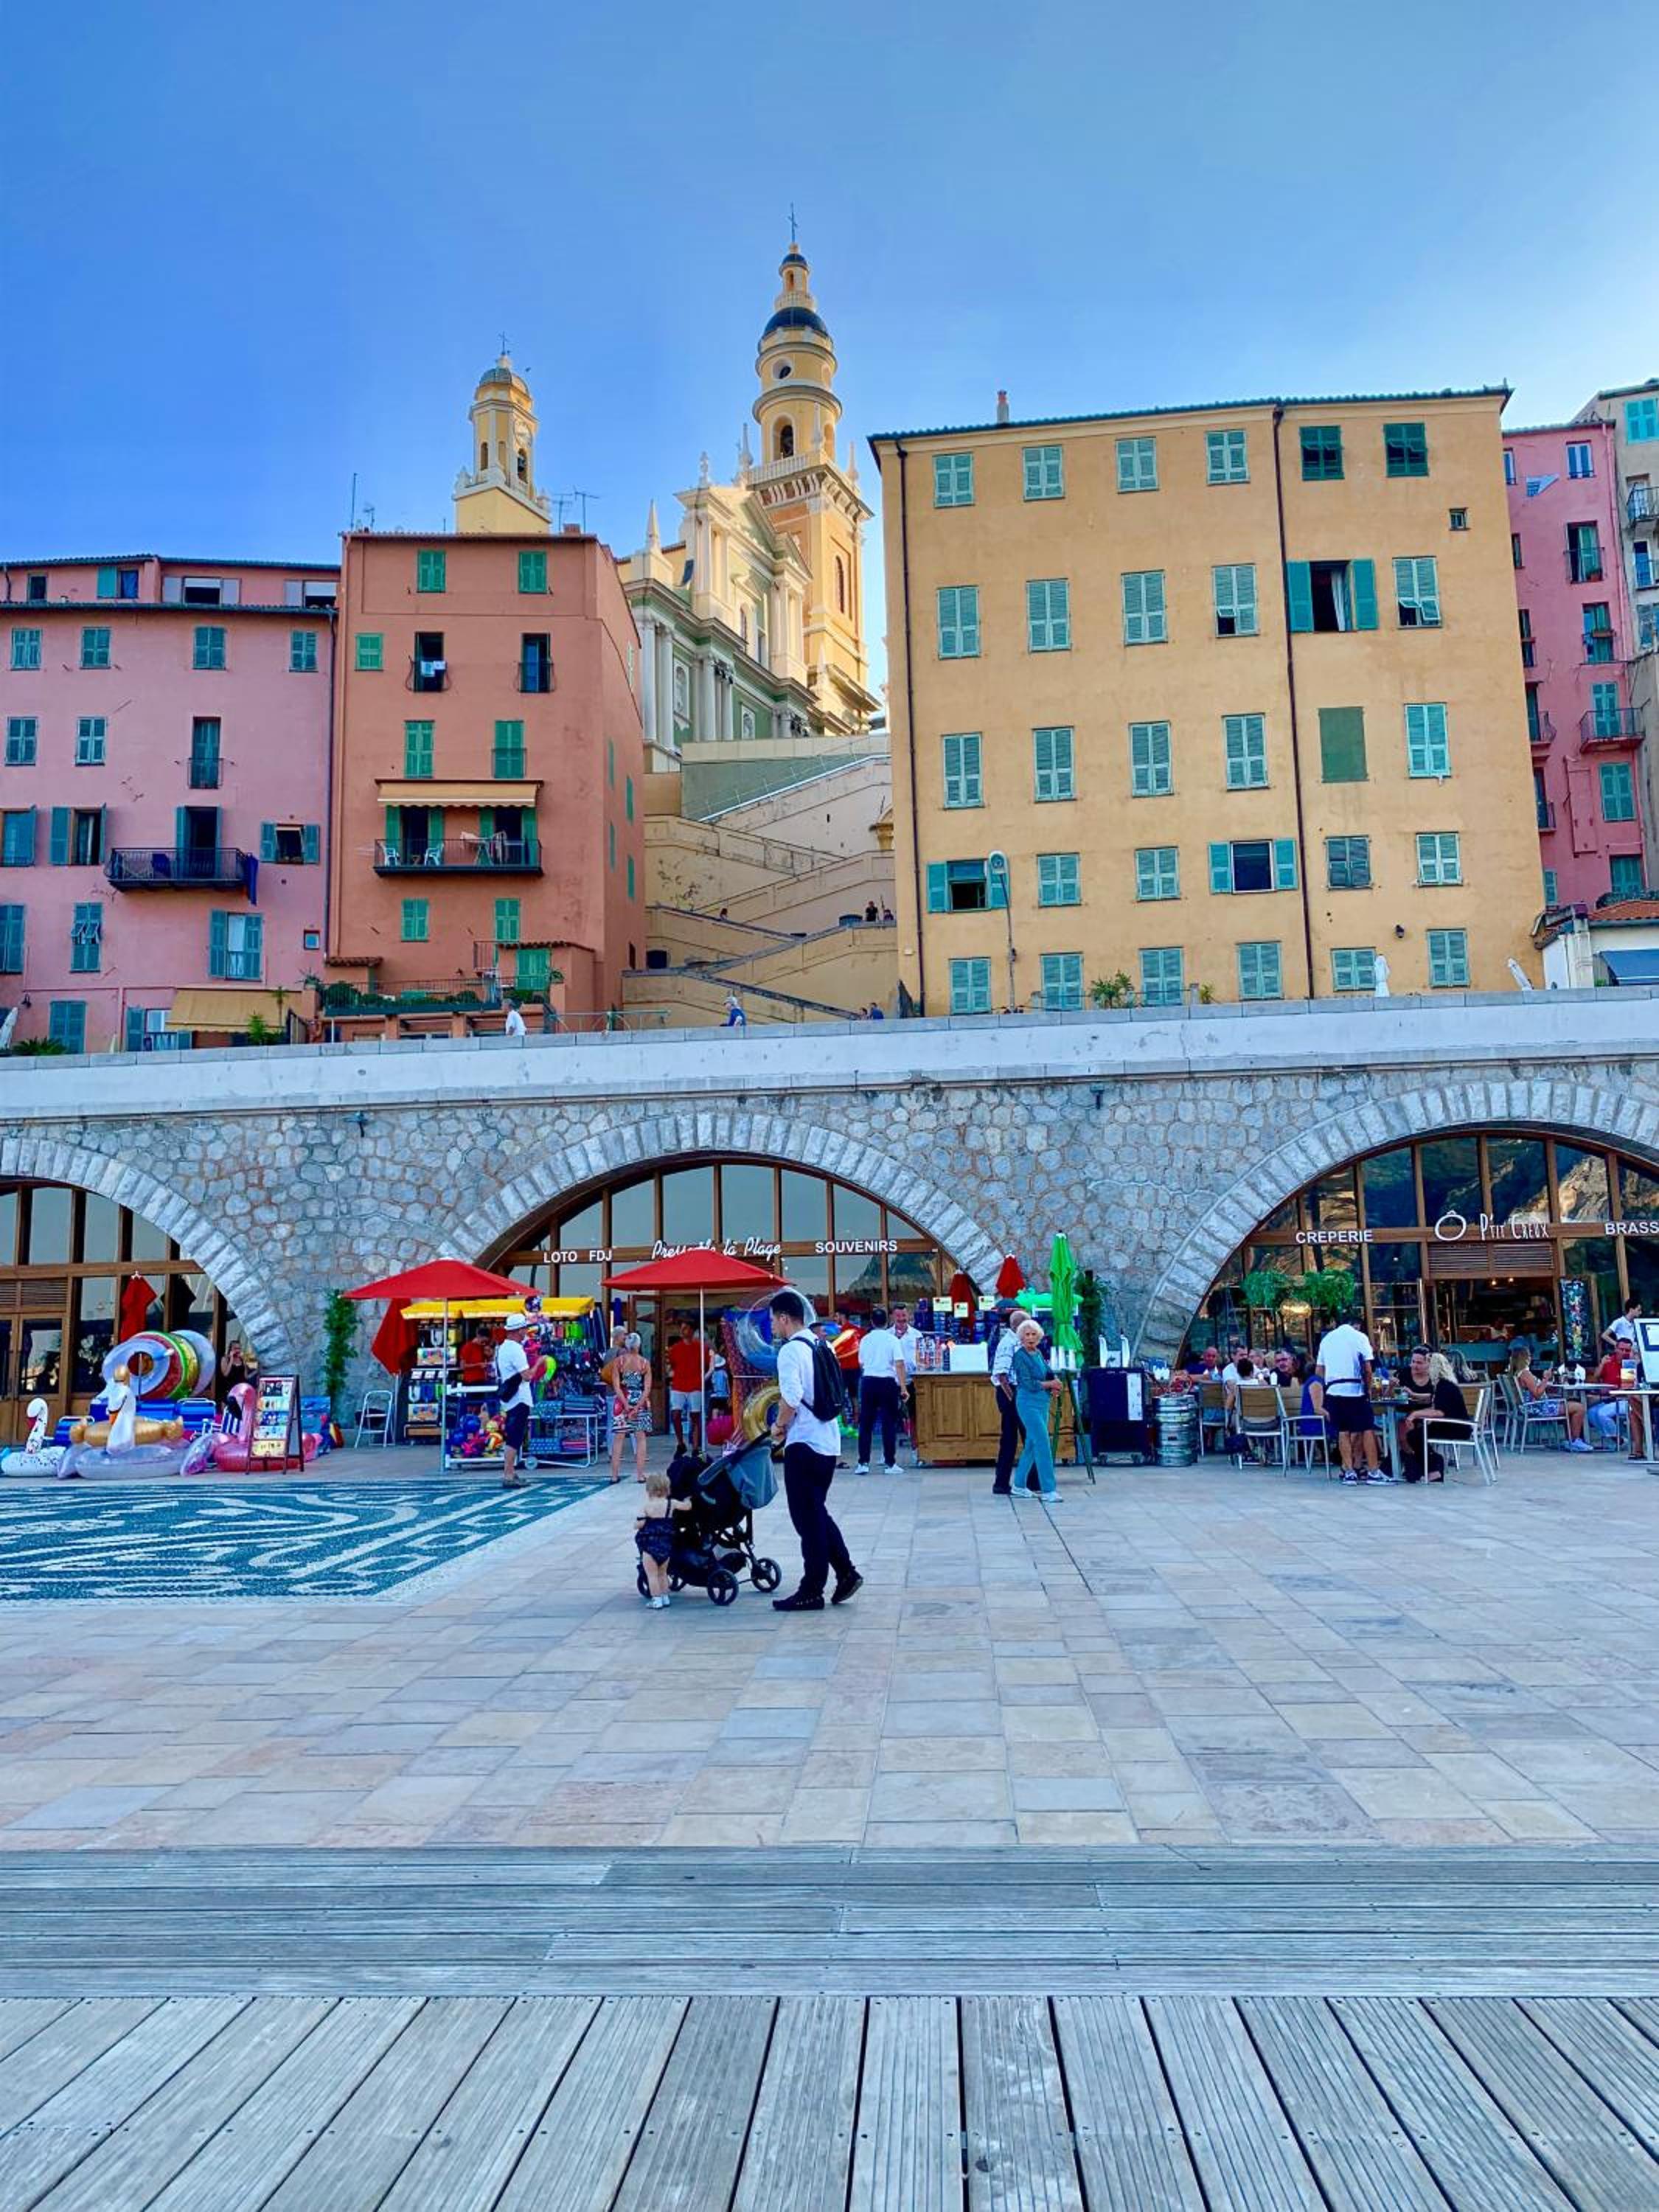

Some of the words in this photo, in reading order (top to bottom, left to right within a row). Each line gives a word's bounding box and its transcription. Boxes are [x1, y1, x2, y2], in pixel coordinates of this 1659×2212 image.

[1604, 1221, 1659, 1235] BRASS
[1295, 1230, 1374, 1244] CREPERIE
[743, 1237, 782, 1262] Plage
[815, 1239, 898, 1253] SOUVENIRS
[543, 1251, 578, 1263] LOTO
[589, 1250, 613, 1262] FDJ
